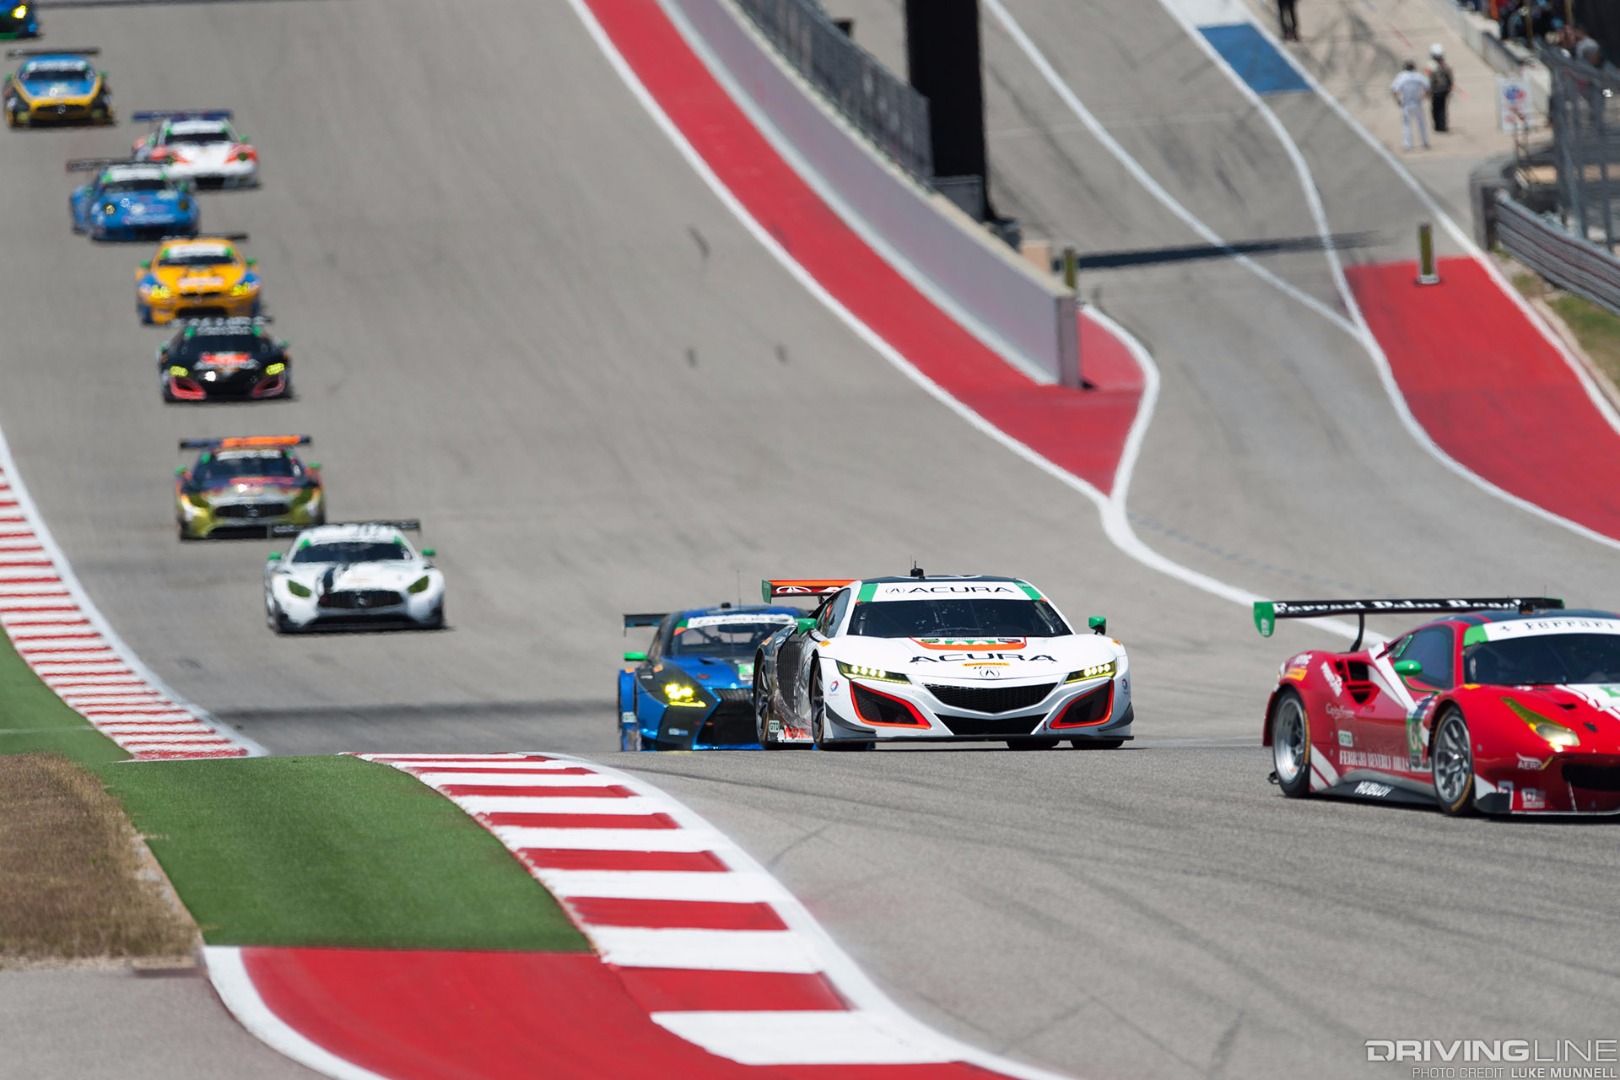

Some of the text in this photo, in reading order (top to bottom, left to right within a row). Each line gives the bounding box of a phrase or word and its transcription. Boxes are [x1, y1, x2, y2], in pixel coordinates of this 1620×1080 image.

[908, 586, 1015, 594] ACURA
[1273, 602, 1366, 614] Ferrari
[1371, 600, 1442, 609] Palm
[1526, 619, 1615, 631] Ferrari
[909, 653, 1058, 664] ACURA
[1354, 780, 1394, 797] HUBLOT
